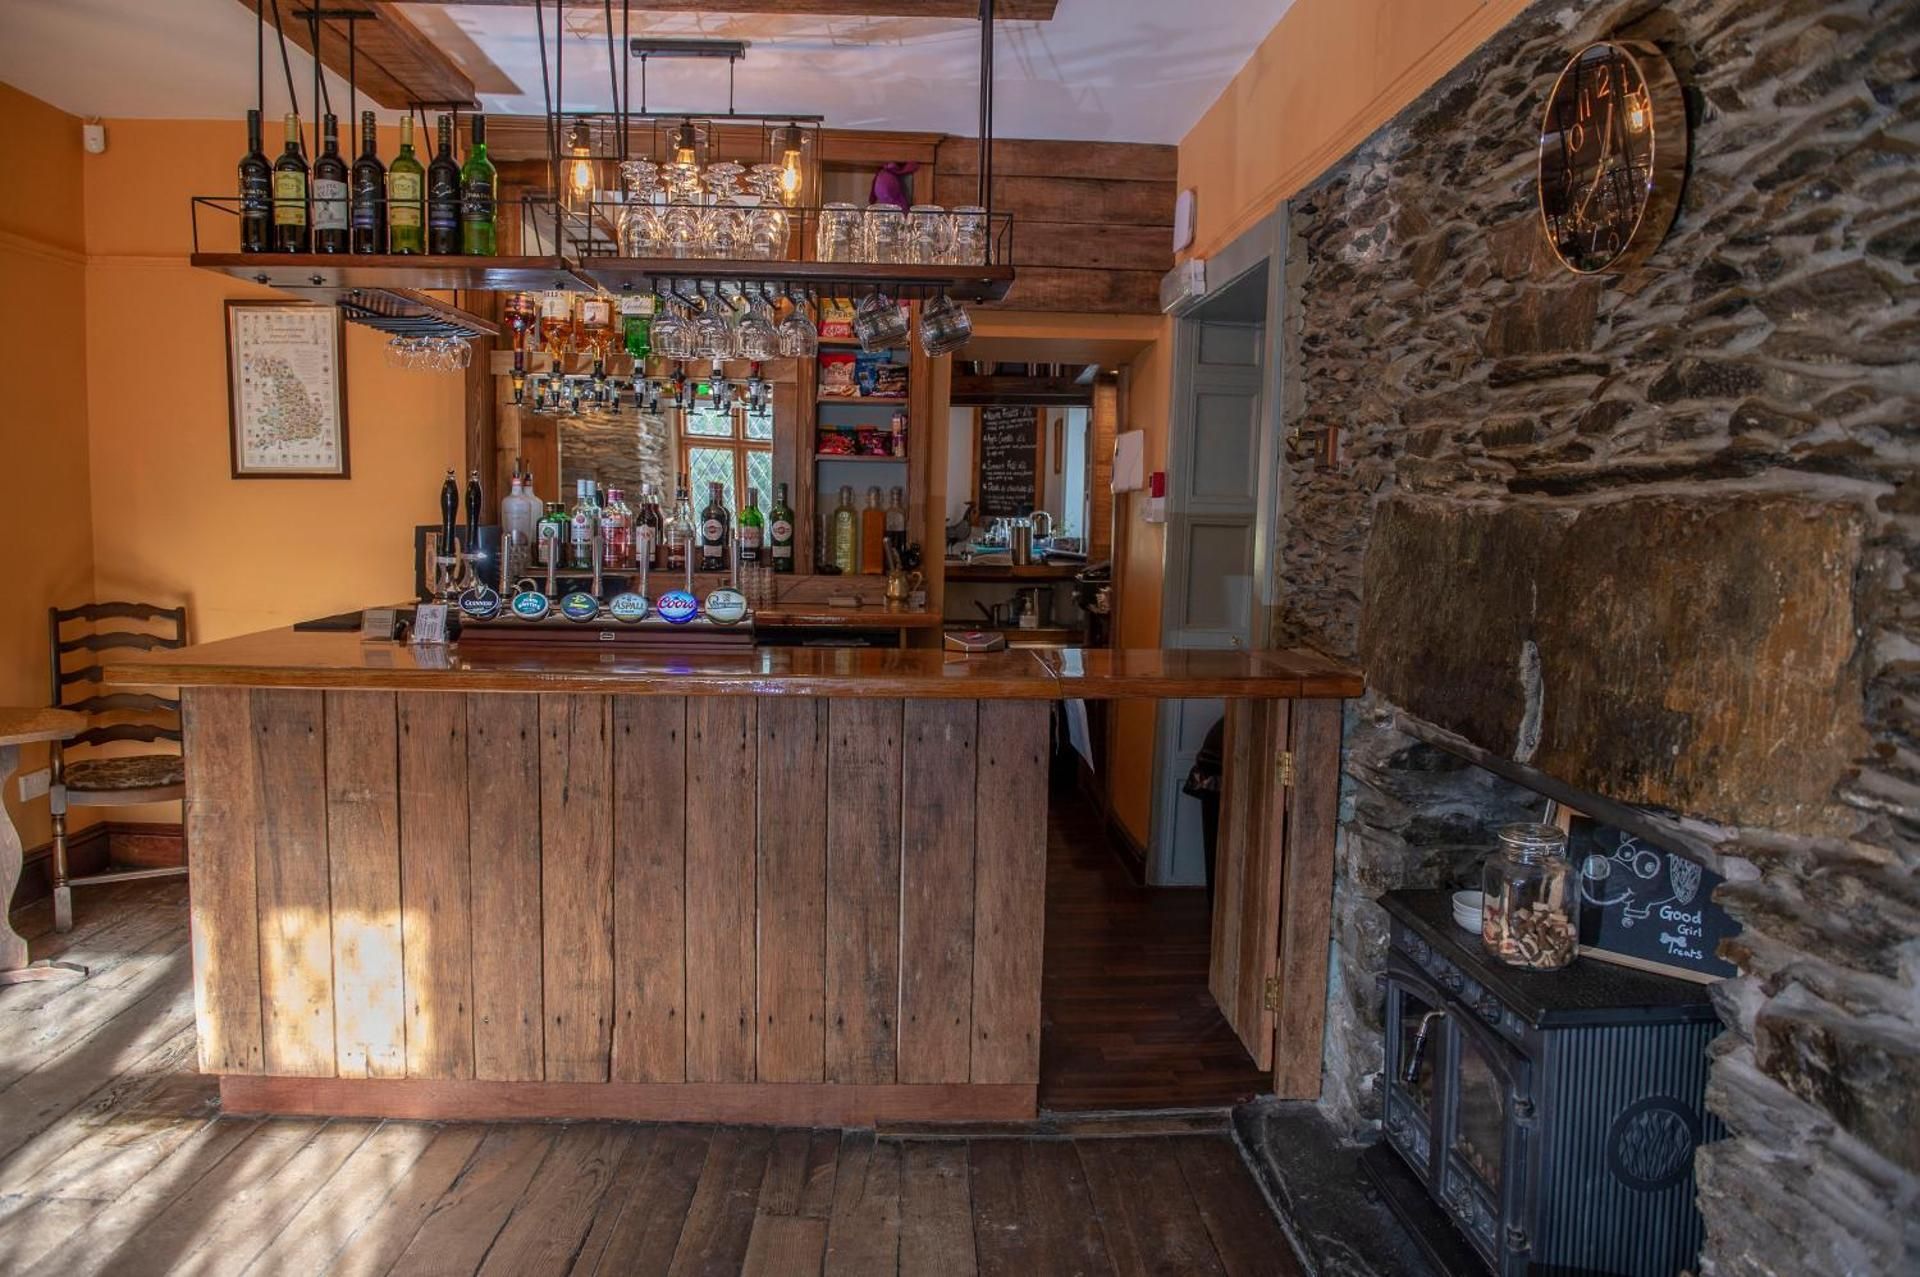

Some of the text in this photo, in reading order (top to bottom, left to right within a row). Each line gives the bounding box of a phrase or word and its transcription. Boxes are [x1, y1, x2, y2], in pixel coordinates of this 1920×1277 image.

[659, 596, 695, 608] Coors
[1659, 905, 1702, 924] Good
[1667, 940, 1703, 960] Treats
